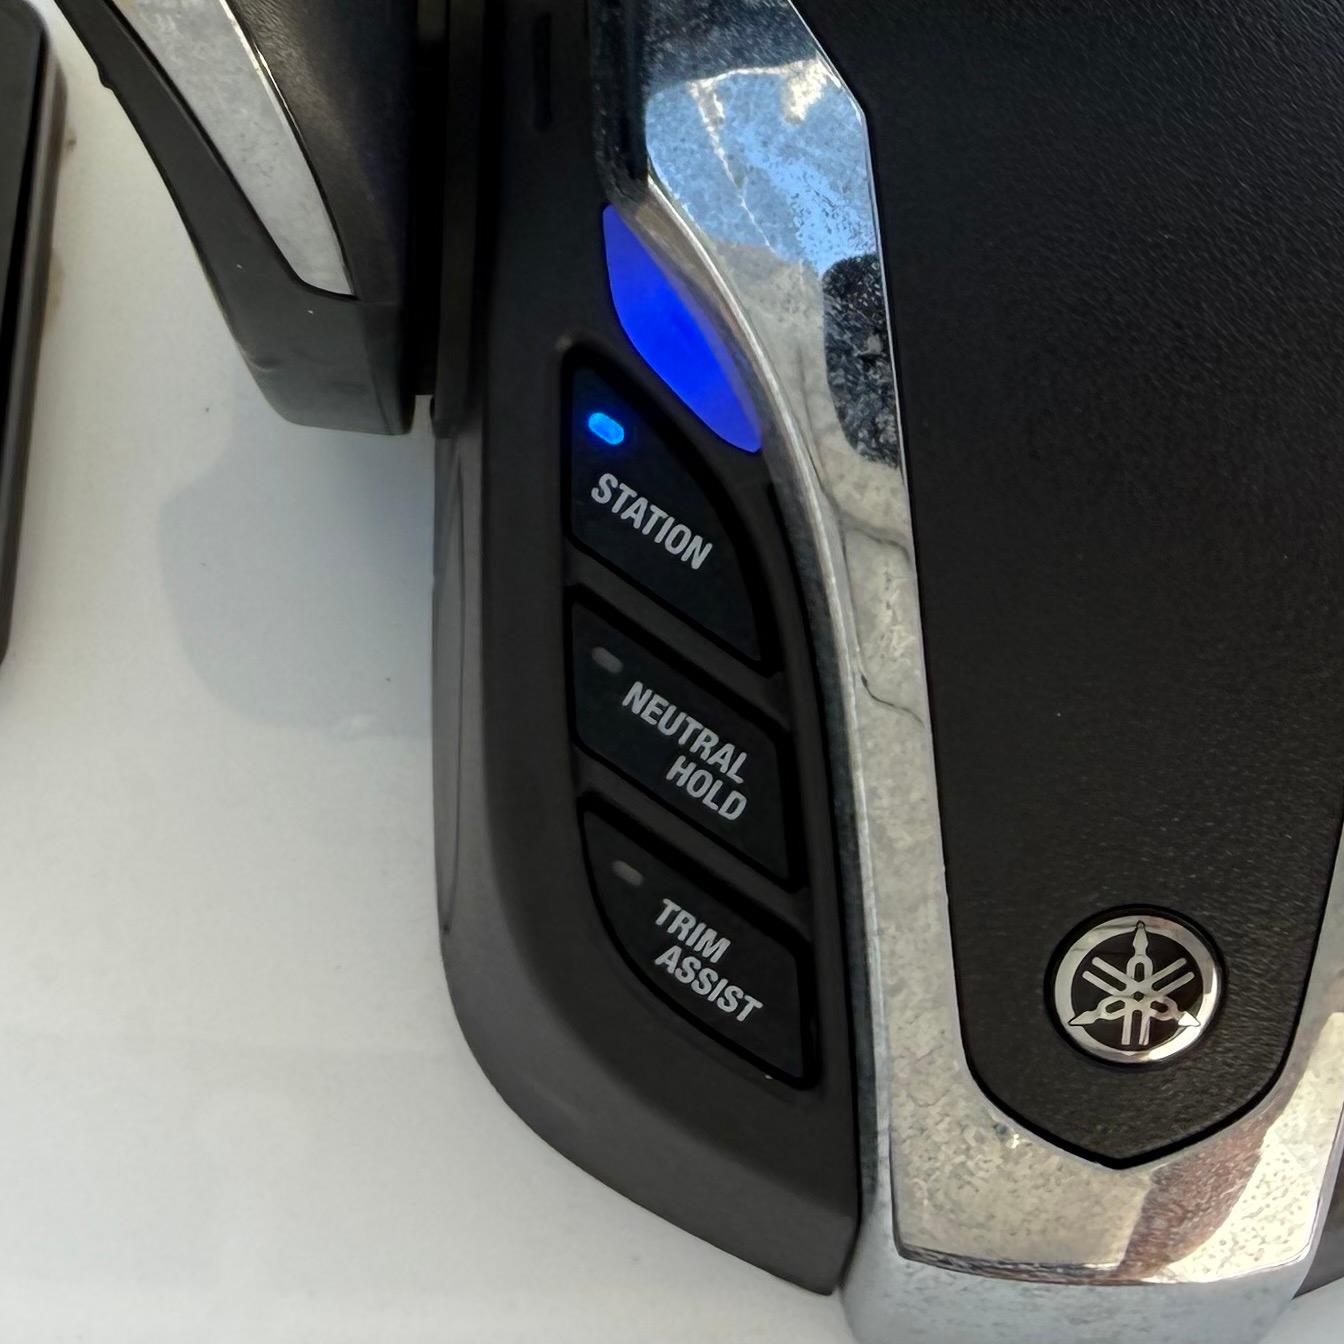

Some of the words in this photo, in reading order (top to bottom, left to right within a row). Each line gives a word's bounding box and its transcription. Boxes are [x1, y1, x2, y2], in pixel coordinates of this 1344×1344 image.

[590, 472, 713, 571] STATION
[621, 681, 749, 785] NEUTRAL
[665, 755, 748, 822] HOLD
[655, 898, 732, 965] TRIM
[654, 945, 763, 1023] ASSIST
